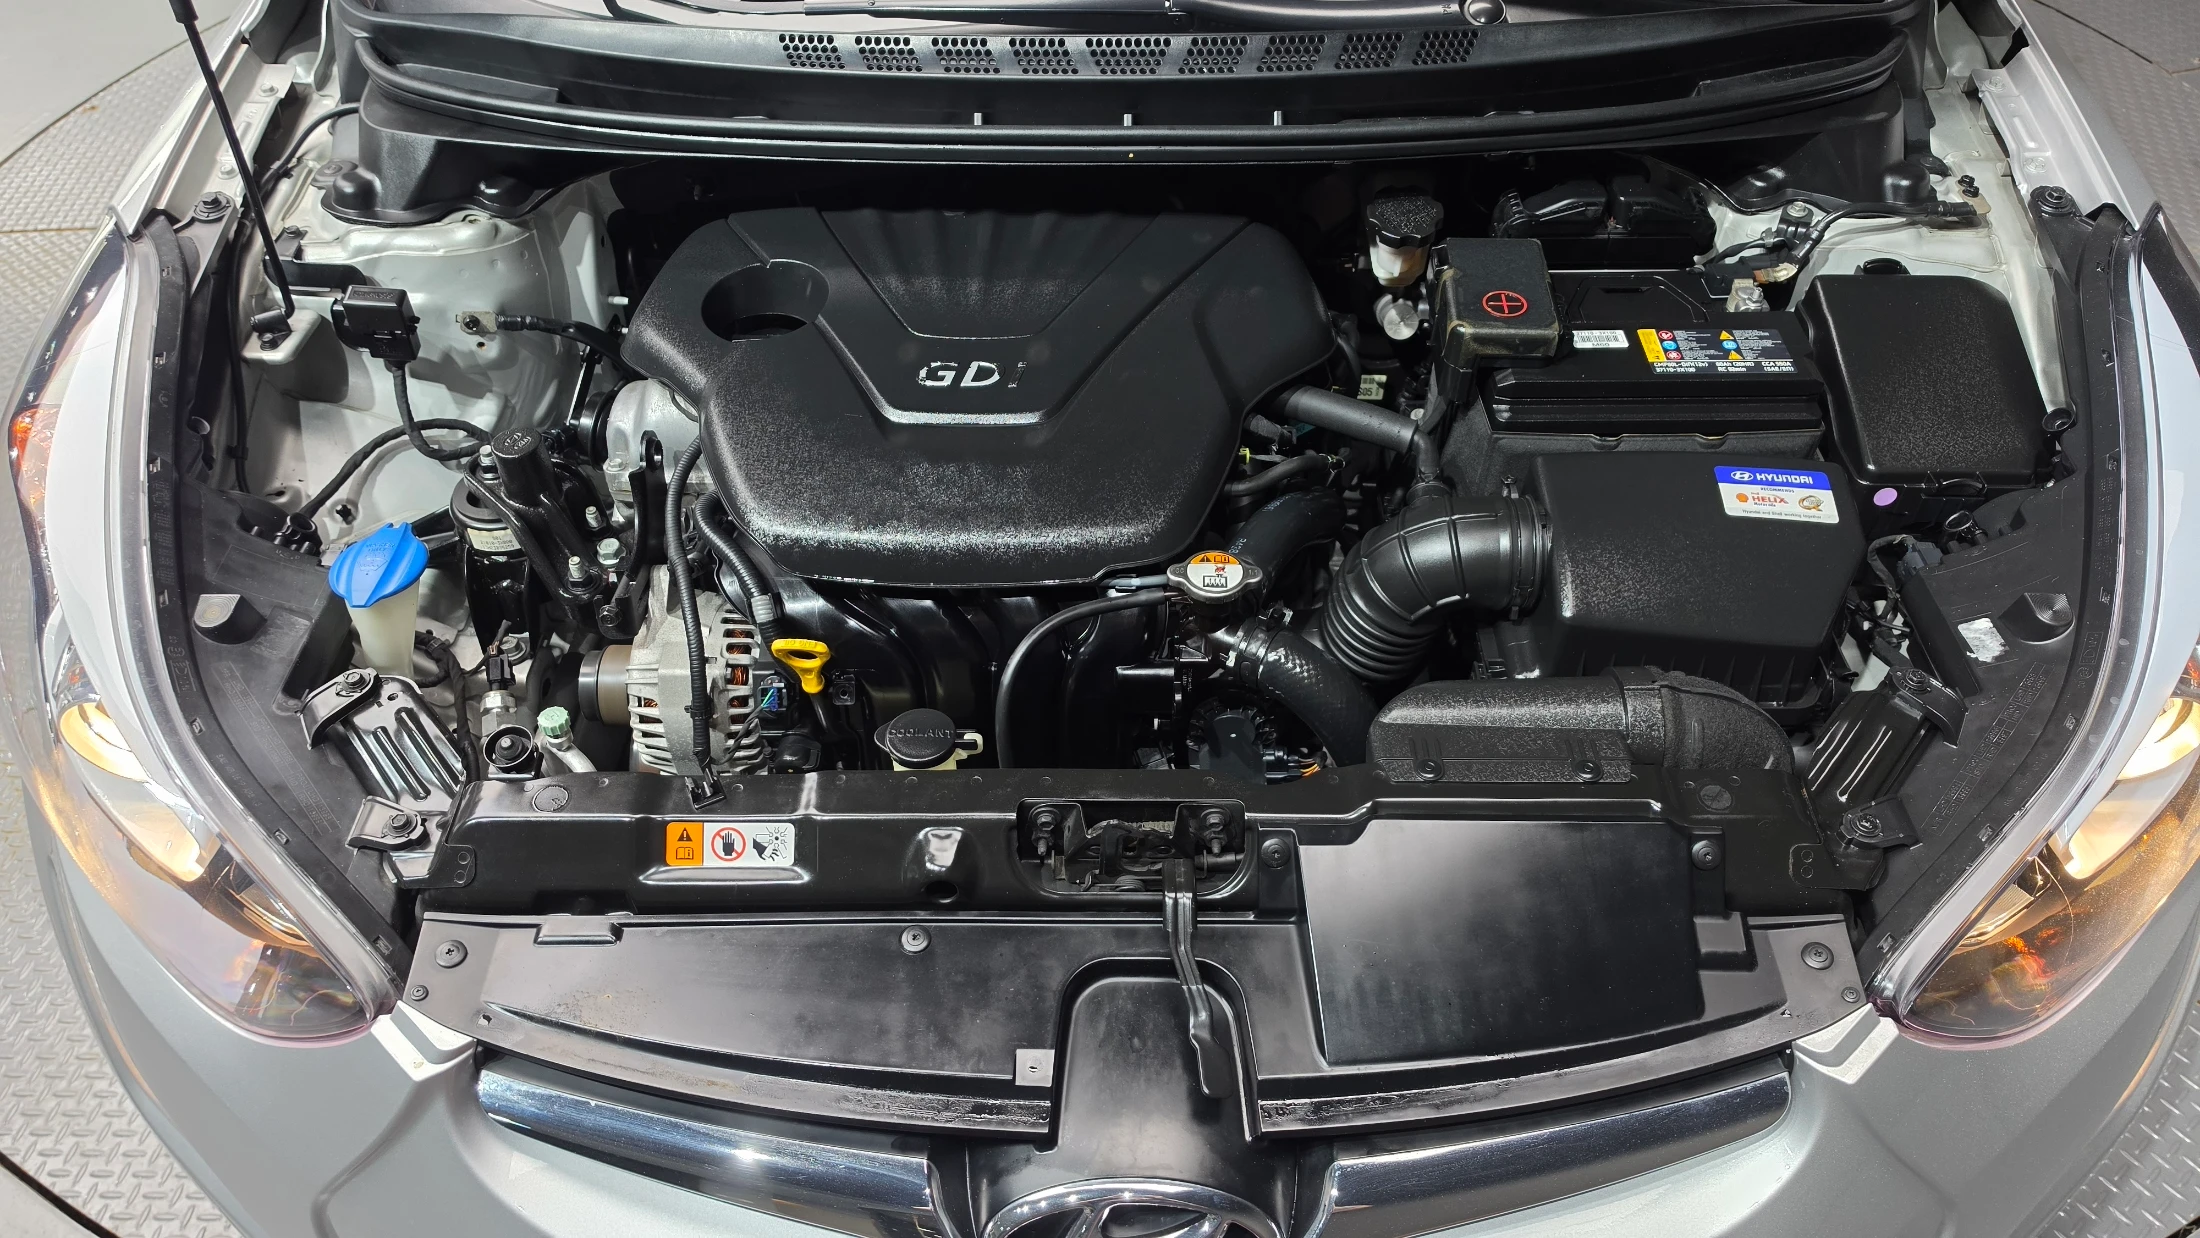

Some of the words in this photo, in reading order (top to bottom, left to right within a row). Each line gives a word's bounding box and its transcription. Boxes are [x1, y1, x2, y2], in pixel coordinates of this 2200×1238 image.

[1756, 472, 1814, 485] HYUNDAI
[1752, 495, 1789, 504] HELIX
[889, 728, 951, 739] COOLANT
